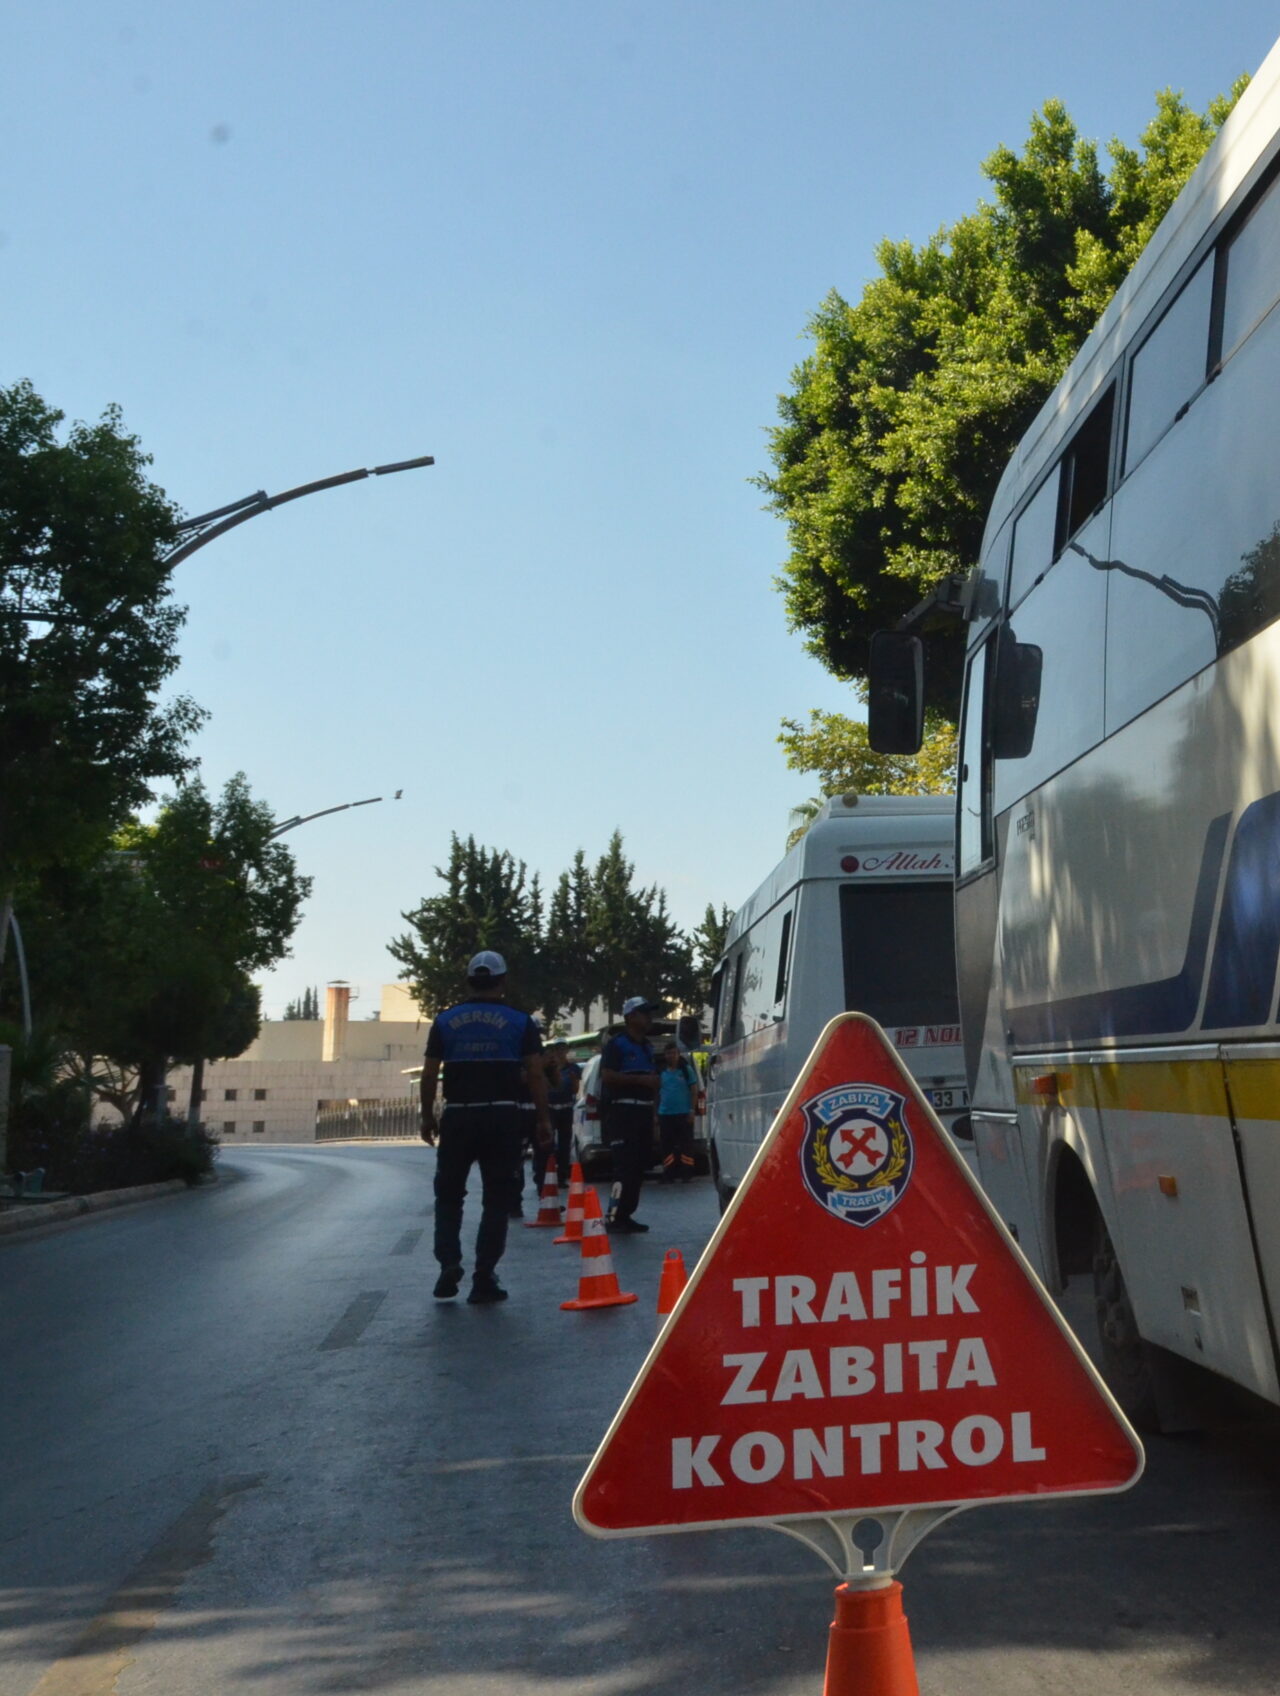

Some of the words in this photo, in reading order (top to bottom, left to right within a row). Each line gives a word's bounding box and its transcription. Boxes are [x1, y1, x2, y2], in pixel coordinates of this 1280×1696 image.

[896, 1029, 917, 1046] 12
[829, 1093, 880, 1109] ZABITA
[934, 1091, 953, 1107] 33
[841, 1192, 886, 1207] TRAFİK
[733, 1250, 980, 1328] TRAFİK
[720, 1337, 998, 1406] ZABITA
[671, 1411, 1046, 1489] KONTROL
